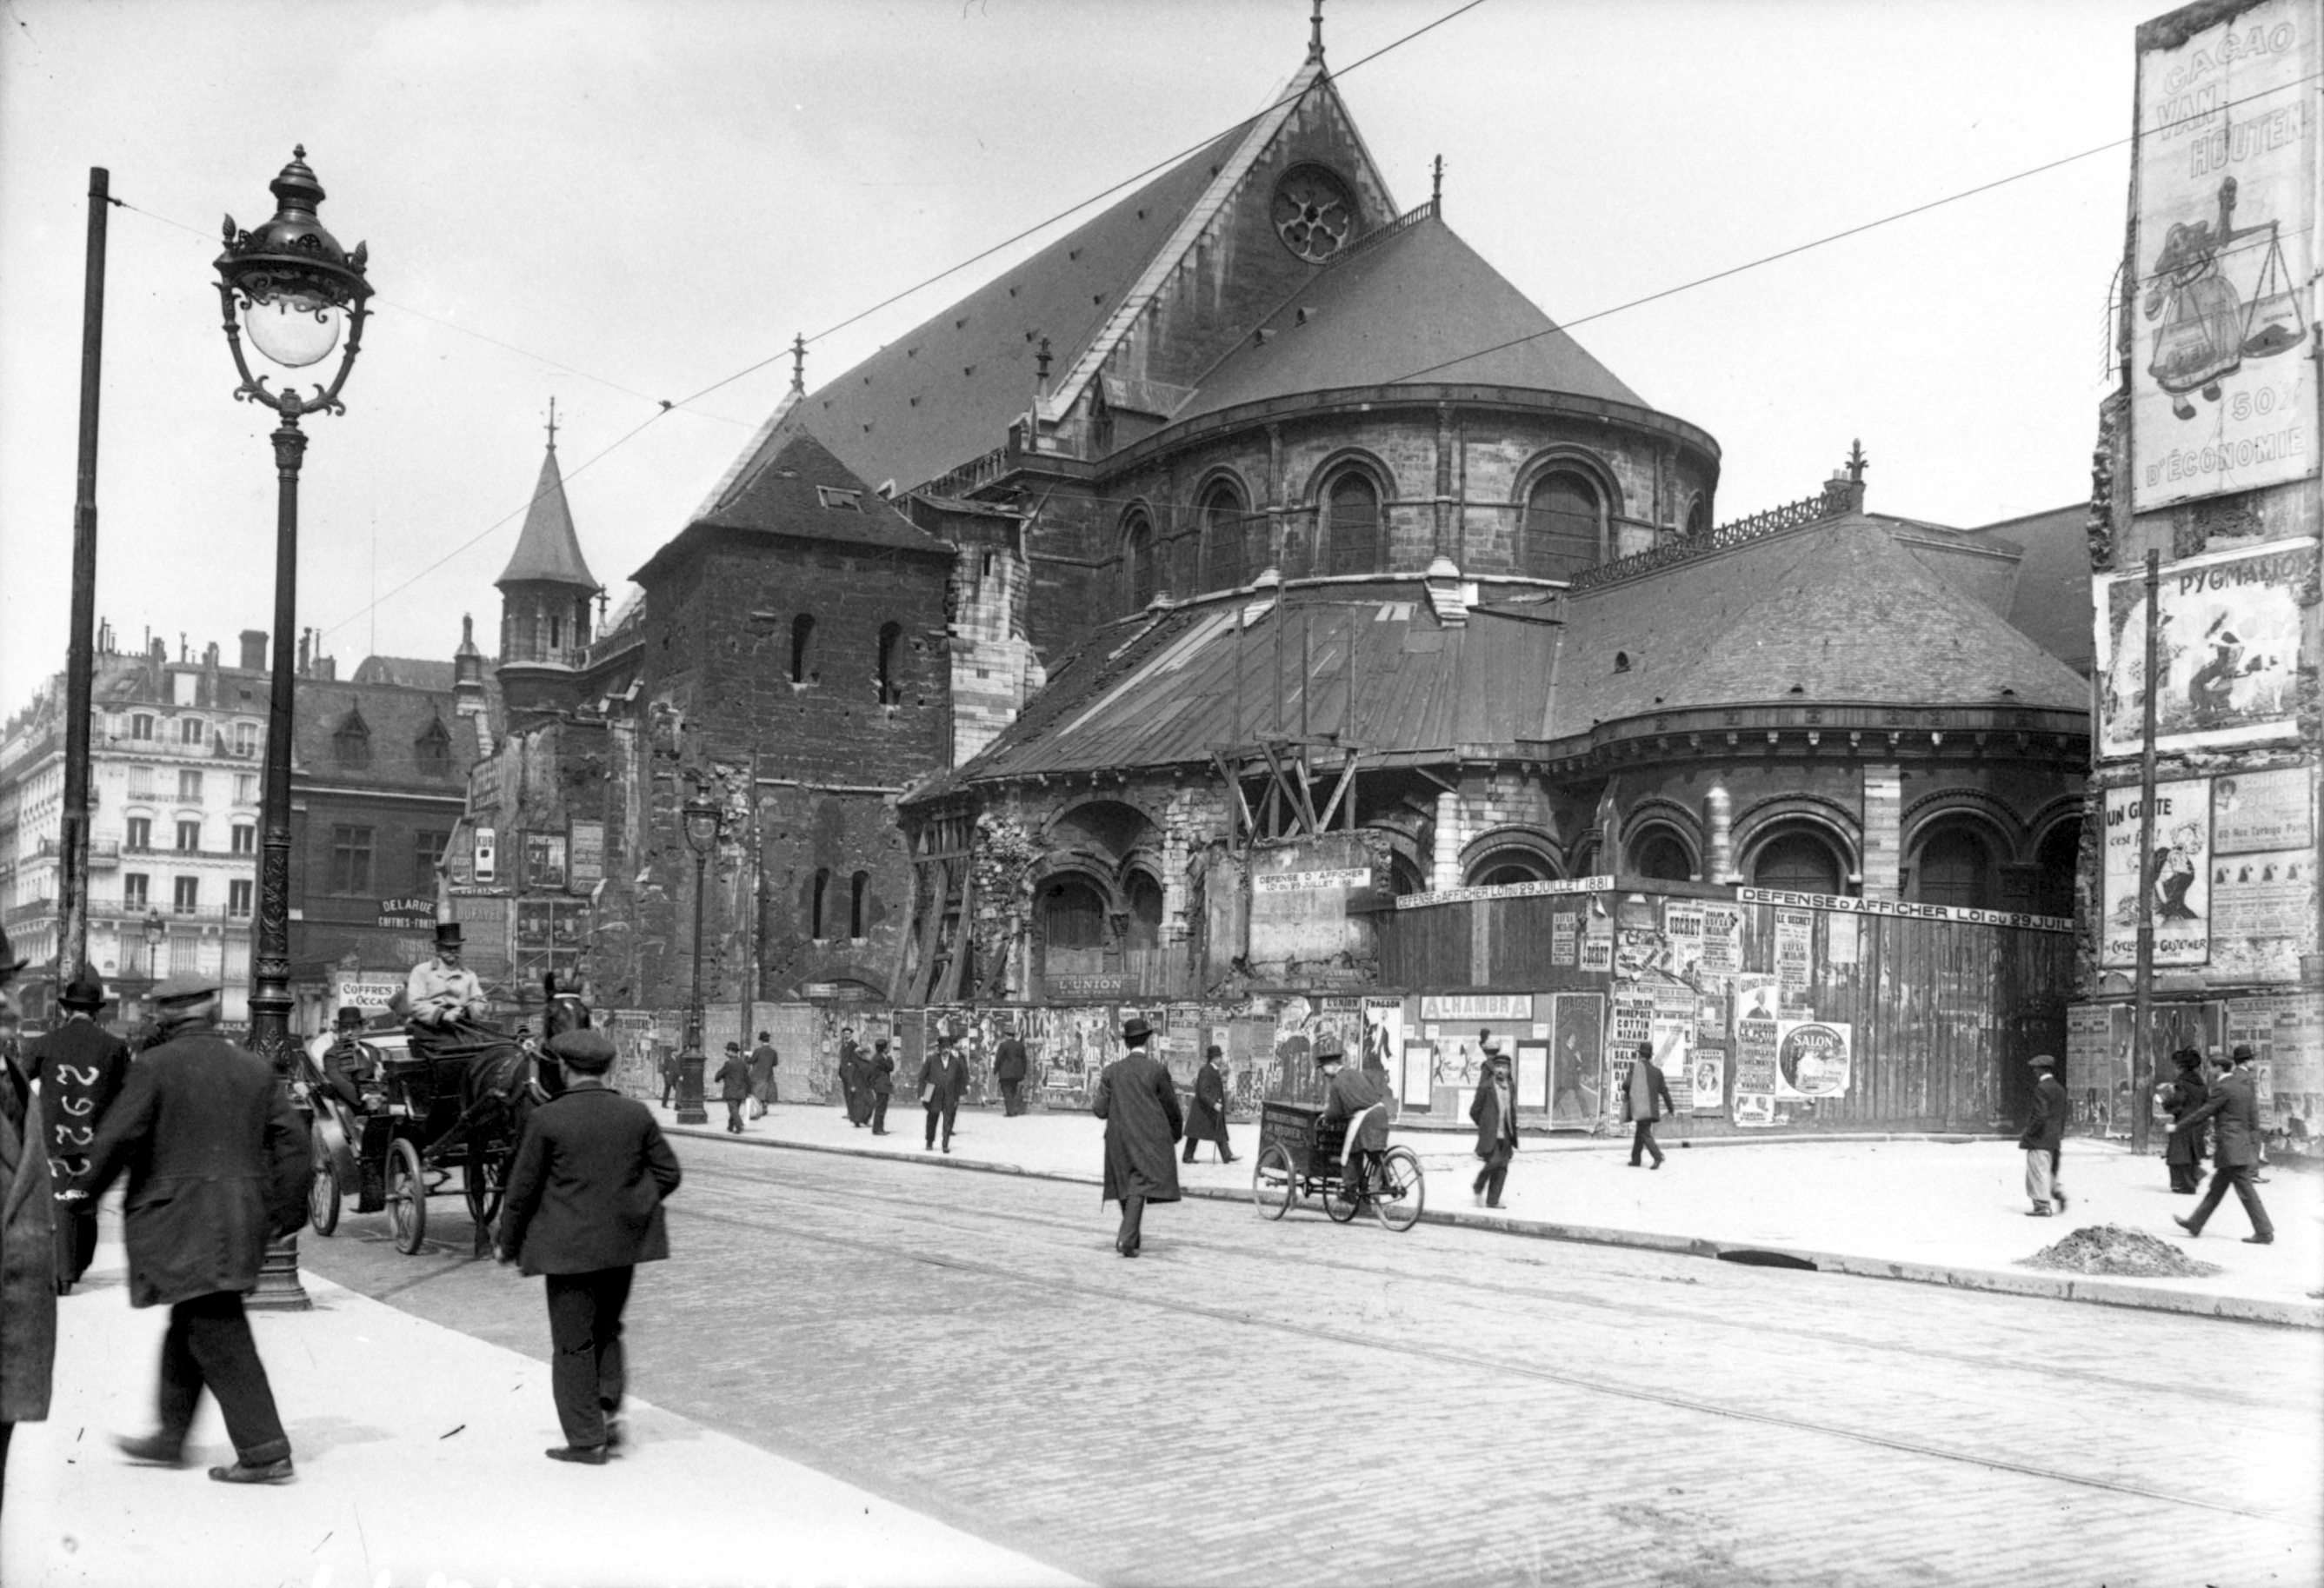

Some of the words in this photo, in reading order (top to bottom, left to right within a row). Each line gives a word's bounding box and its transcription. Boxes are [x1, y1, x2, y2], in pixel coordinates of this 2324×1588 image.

[2164, 21, 2296, 96] CACAO
[2156, 84, 2216, 142] VAN
[2190, 99, 2306, 179] HOUTEN
[2146, 427, 2304, 488] D'ÉCONOMIE
[2107, 805, 2125, 827] UN
[2128, 798, 2172, 820] GTE
[476, 835, 494, 847] KUB
[1319, 869, 1364, 880] AFFICHER
[1302, 880, 1334, 889] JUILLET
[1491, 885, 1508, 897] LOI
[1519, 882, 1535, 895] 29
[1535, 880, 1582, 894] JUILLET
[1585, 877, 1608, 890] 1881
[383, 899, 435, 914] DELARUE
[1957, 908, 1985, 922] LOI
[1989, 914, 2007, 924] DU
[2010, 914, 2032, 927] 29
[1669, 916, 1701, 936] SECRET
[2160, 939, 2207, 953] GESTETNER
[1058, 979, 1122, 989] L'UNION
[1366, 1000, 1401, 1011] FRAGSON
[1424, 995, 1531, 1020] ALHAMBRA
[1616, 1008, 1652, 1019] MIREPOIX
[1616, 1019, 1650, 1030] COTTIN
[1616, 1029, 1649, 1040] NIZARD
[1793, 1034, 1835, 1048] SALON
